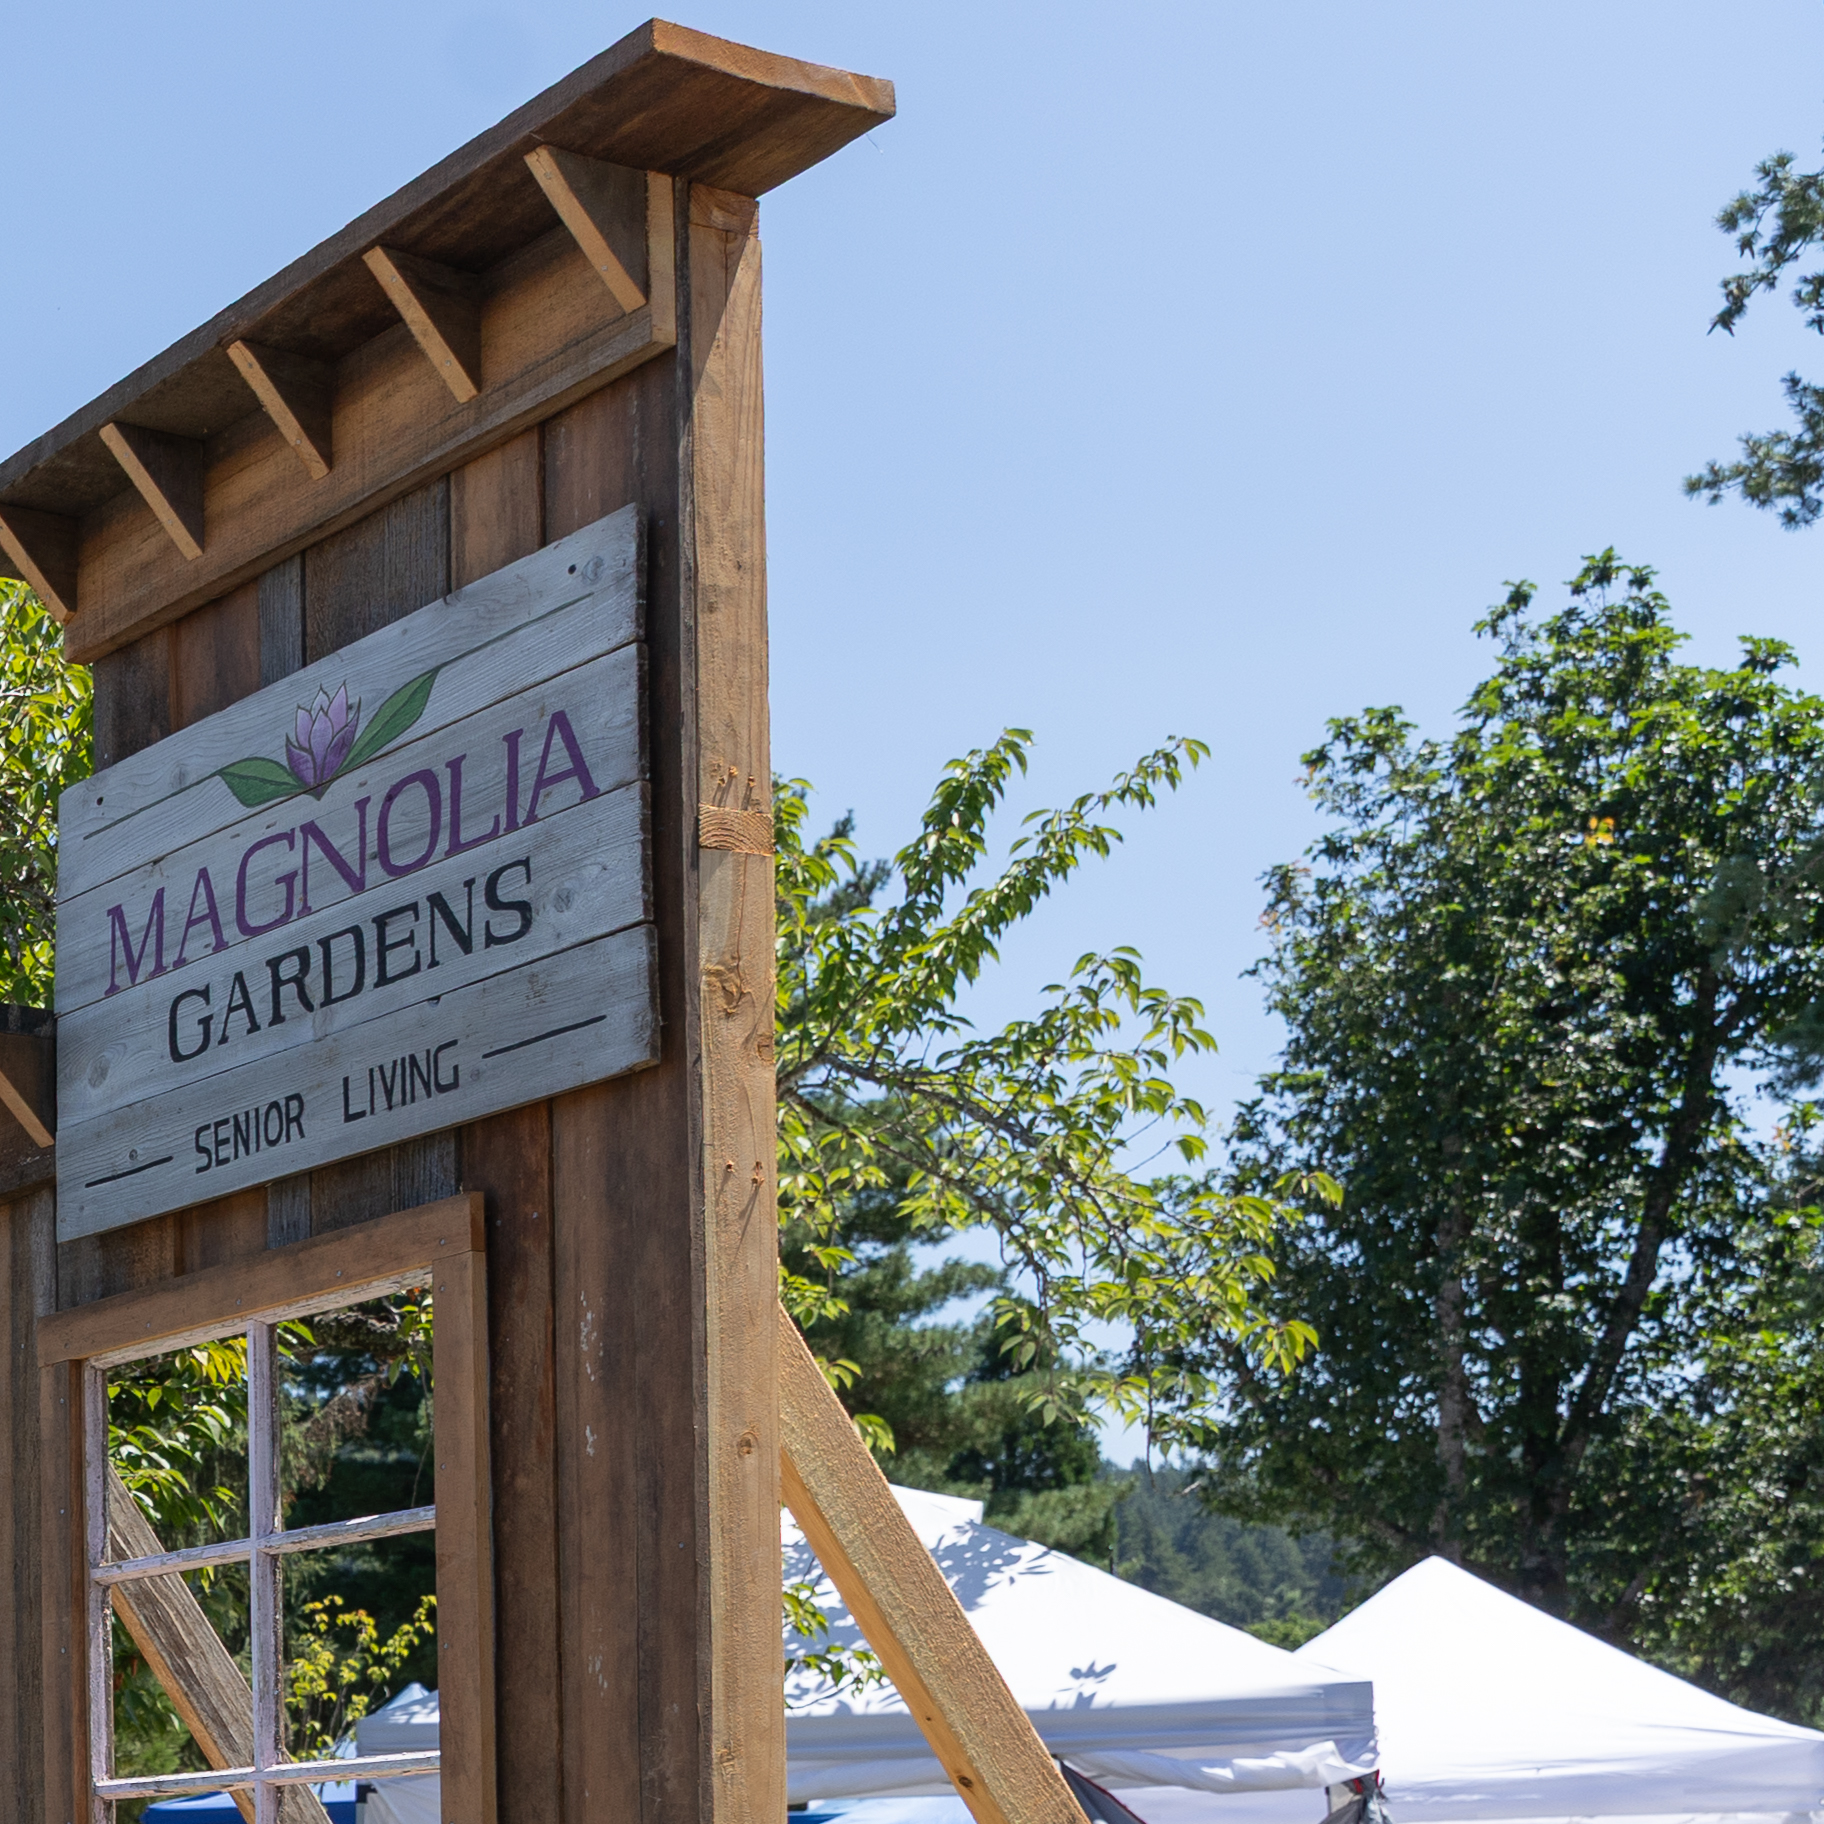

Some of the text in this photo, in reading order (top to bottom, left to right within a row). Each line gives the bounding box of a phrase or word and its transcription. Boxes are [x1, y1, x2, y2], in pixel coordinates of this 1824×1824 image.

[105, 708, 600, 997] MAGNOLIA
[167, 857, 533, 1064] GARDENS
[194, 1039, 460, 1175] SENIOR LIVING
